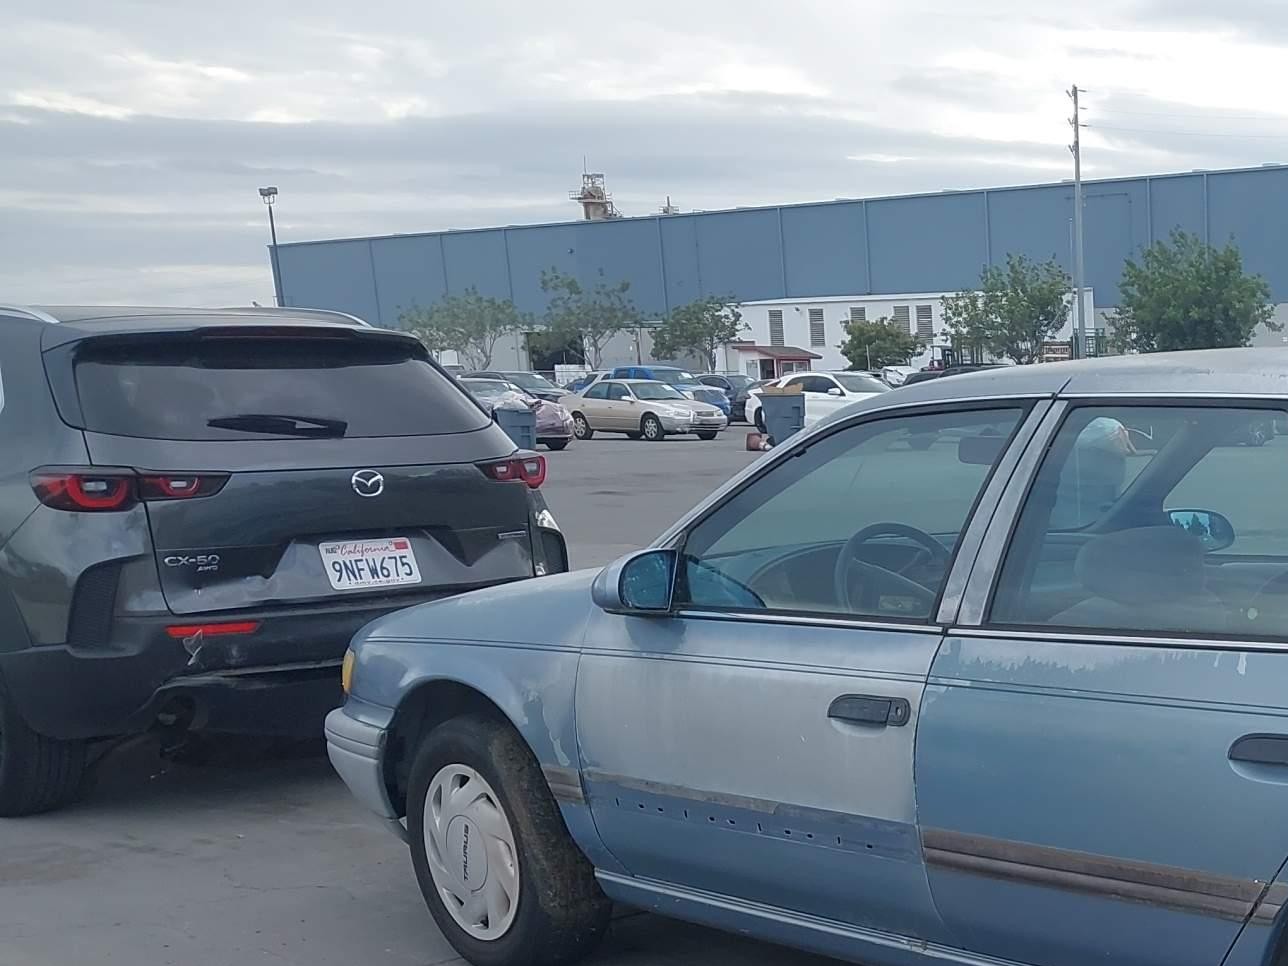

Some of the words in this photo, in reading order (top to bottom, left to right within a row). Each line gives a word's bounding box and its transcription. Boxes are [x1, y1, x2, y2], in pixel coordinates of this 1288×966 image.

[340, 543, 396, 557] California
[164, 555, 220, 567] CX-50
[331, 555, 413, 583] 9NFW675
